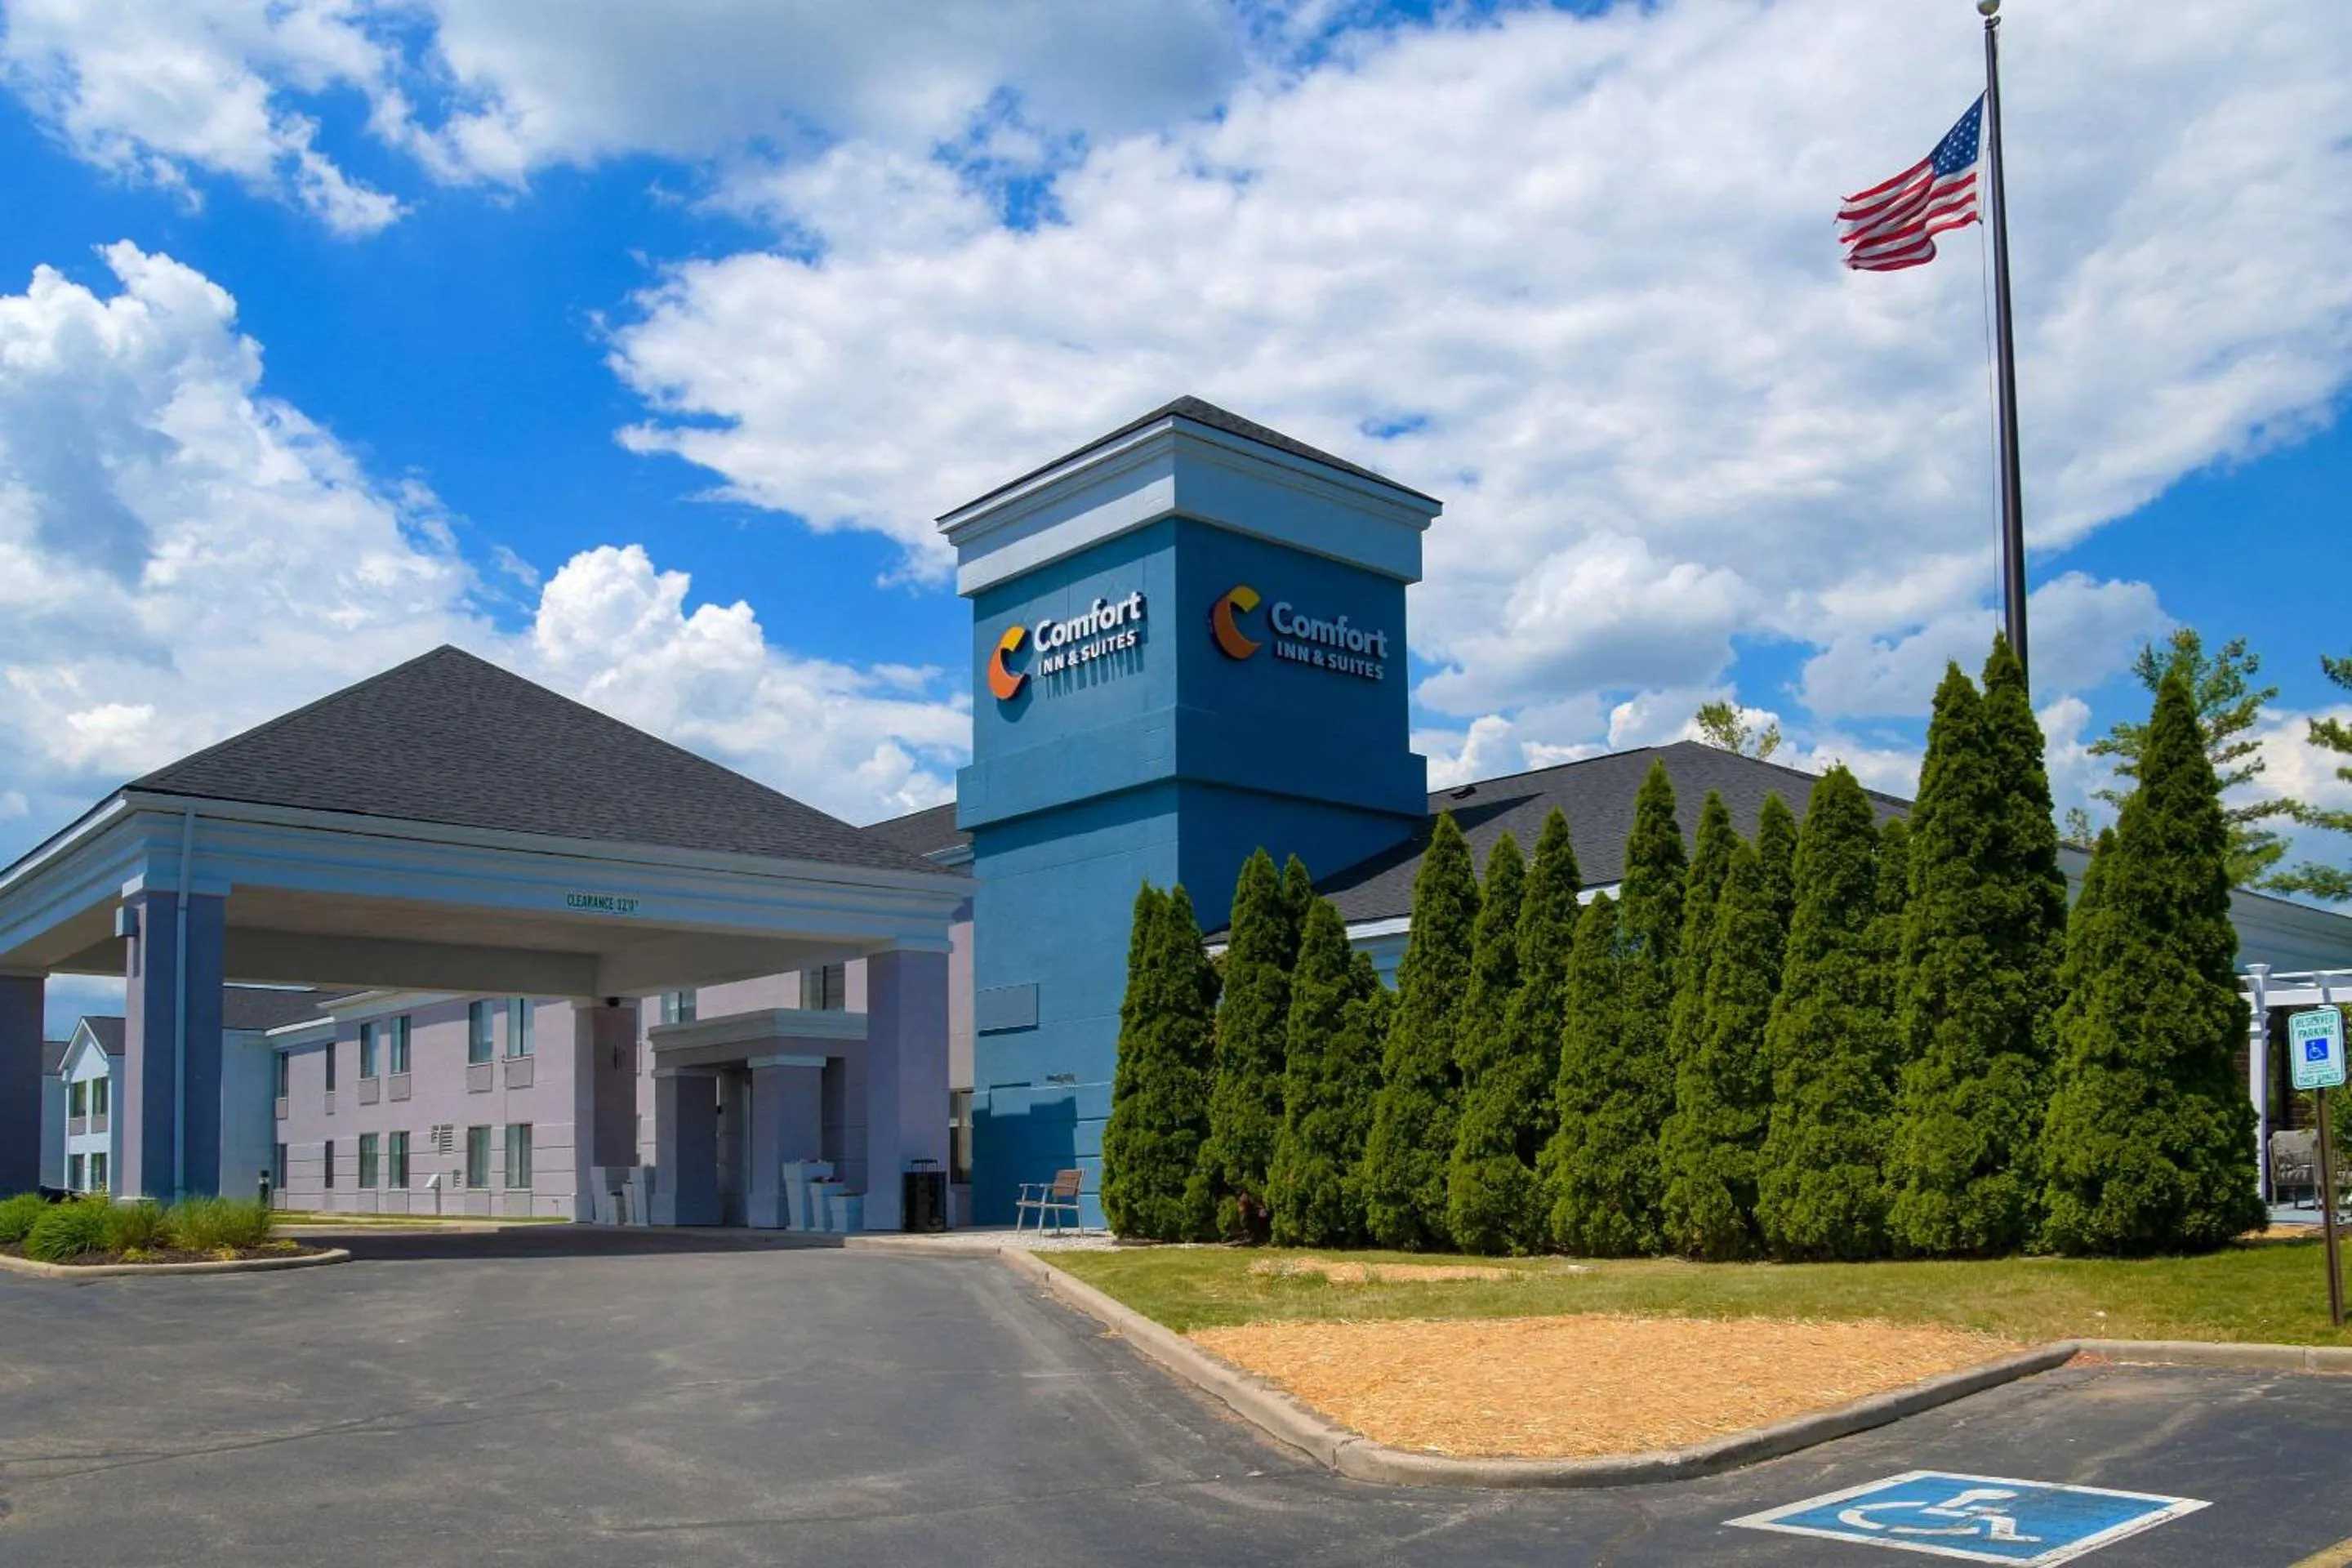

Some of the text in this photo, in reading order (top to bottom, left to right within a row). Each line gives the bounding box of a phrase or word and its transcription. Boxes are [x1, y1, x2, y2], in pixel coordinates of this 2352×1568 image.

[1034, 591, 1142, 652] Comfort
[1272, 601, 1388, 658] Comfort
[1038, 630, 1136, 676] INN & SUITES
[1277, 641, 1384, 680] INN & SUITES
[567, 893, 614, 910] CLEARANCE
[2296, 1013, 2335, 1027] RESERVED
[2298, 1025, 2335, 1038] PARKING
